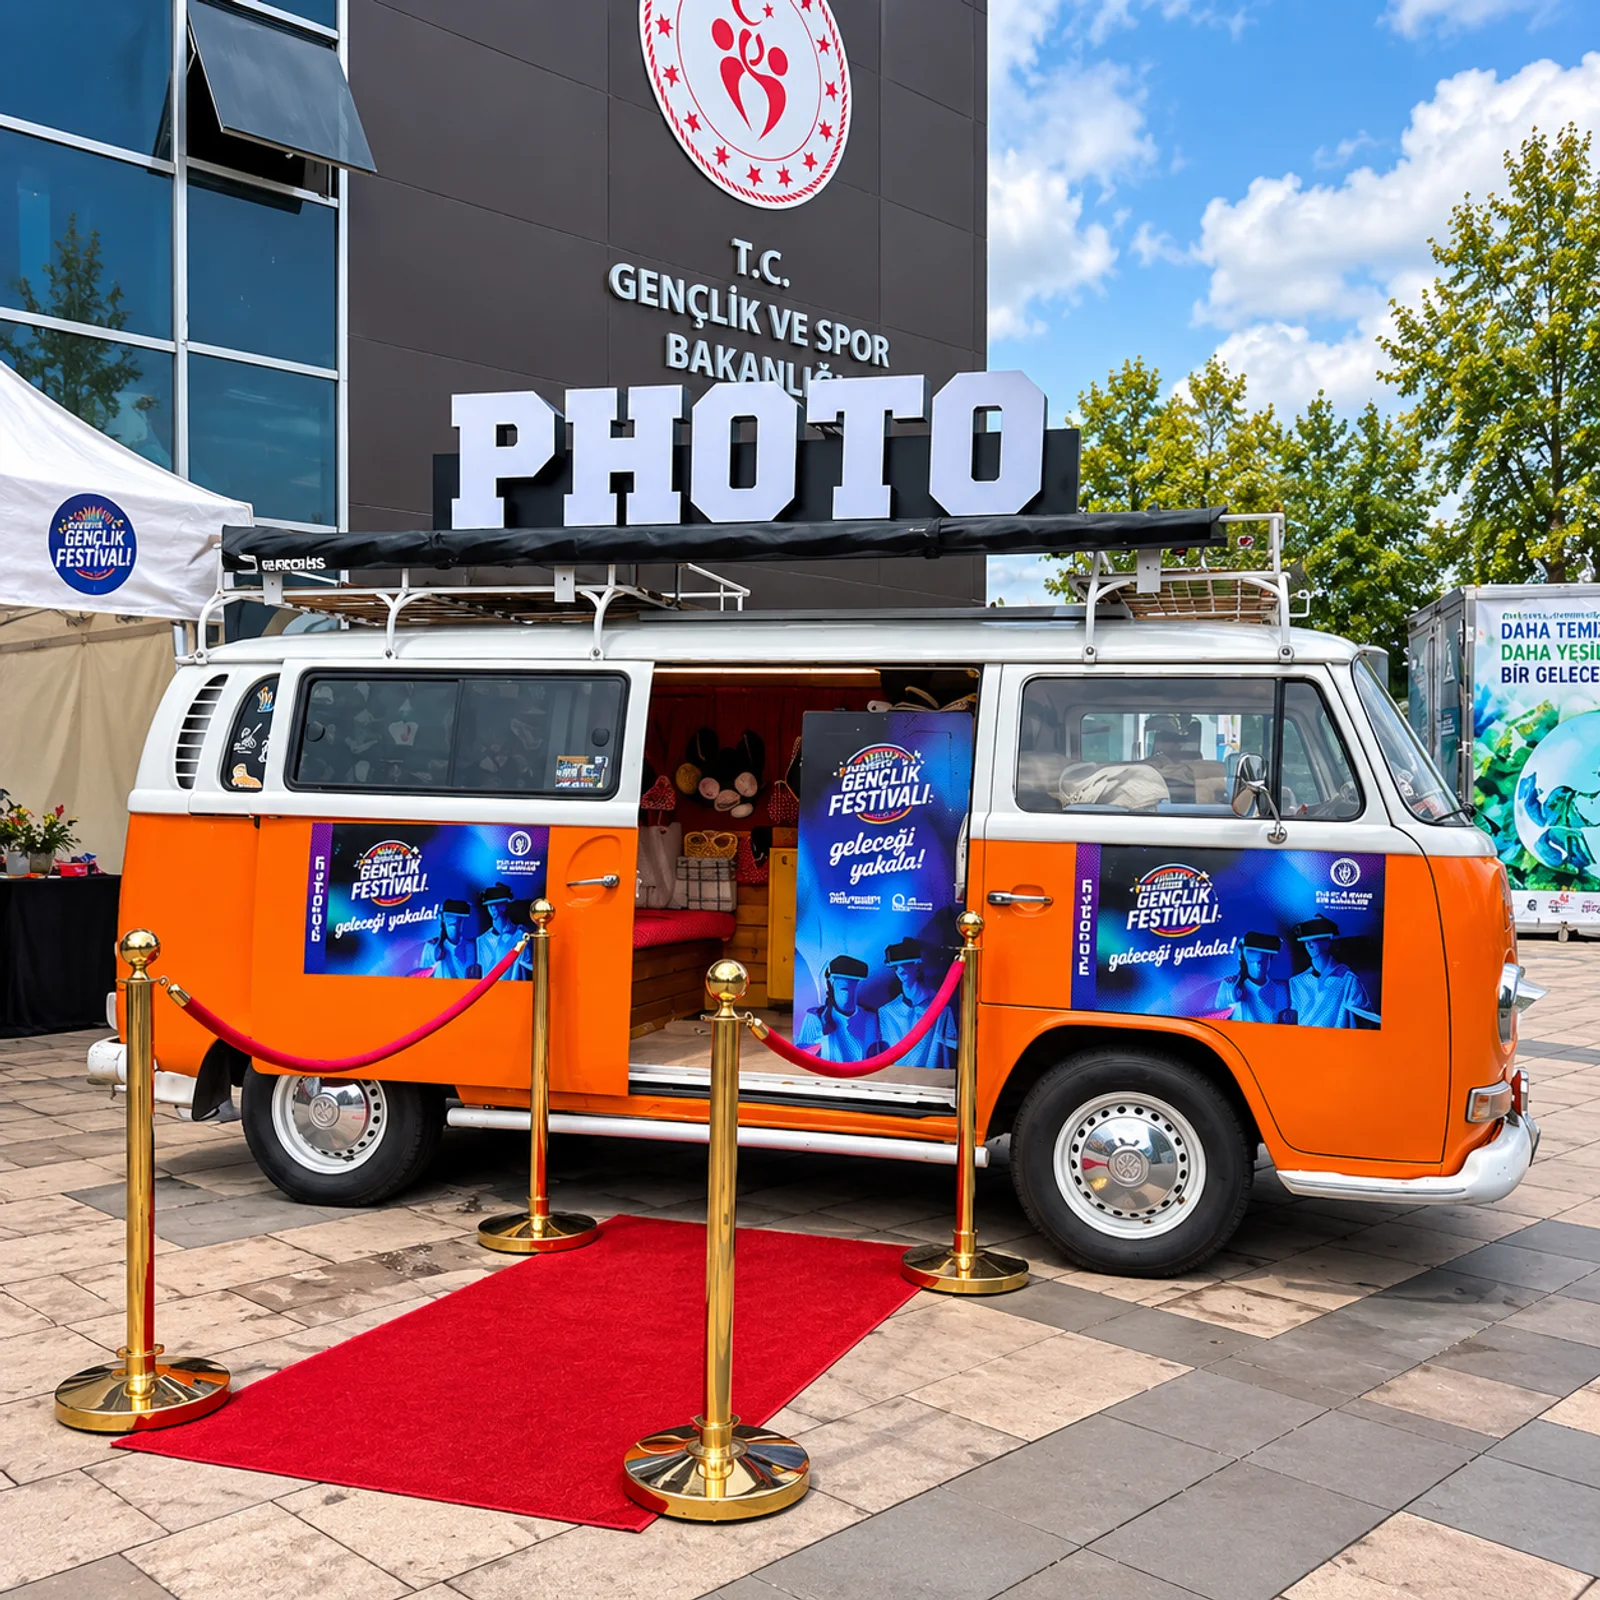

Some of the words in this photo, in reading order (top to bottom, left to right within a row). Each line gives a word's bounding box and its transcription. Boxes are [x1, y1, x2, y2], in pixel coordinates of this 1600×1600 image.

[731, 238, 790, 288] T.C.
[608, 263, 762, 329] GENÇLİK
[768, 304, 808, 347] VE
[814, 319, 890, 368] SPOR
[451, 370, 1047, 530] PHOTO
[1501, 622, 1551, 639] DAHA
[1556, 622, 1600, 639] TEMI
[1501, 644, 1551, 661] DAHA
[1501, 663, 1529, 683] BİR
[829, 827, 916, 866] geleceği
[850, 849, 925, 885] yakala!
[388, 904, 439, 932] yakala!
[1174, 936, 1237, 966] yakala!
